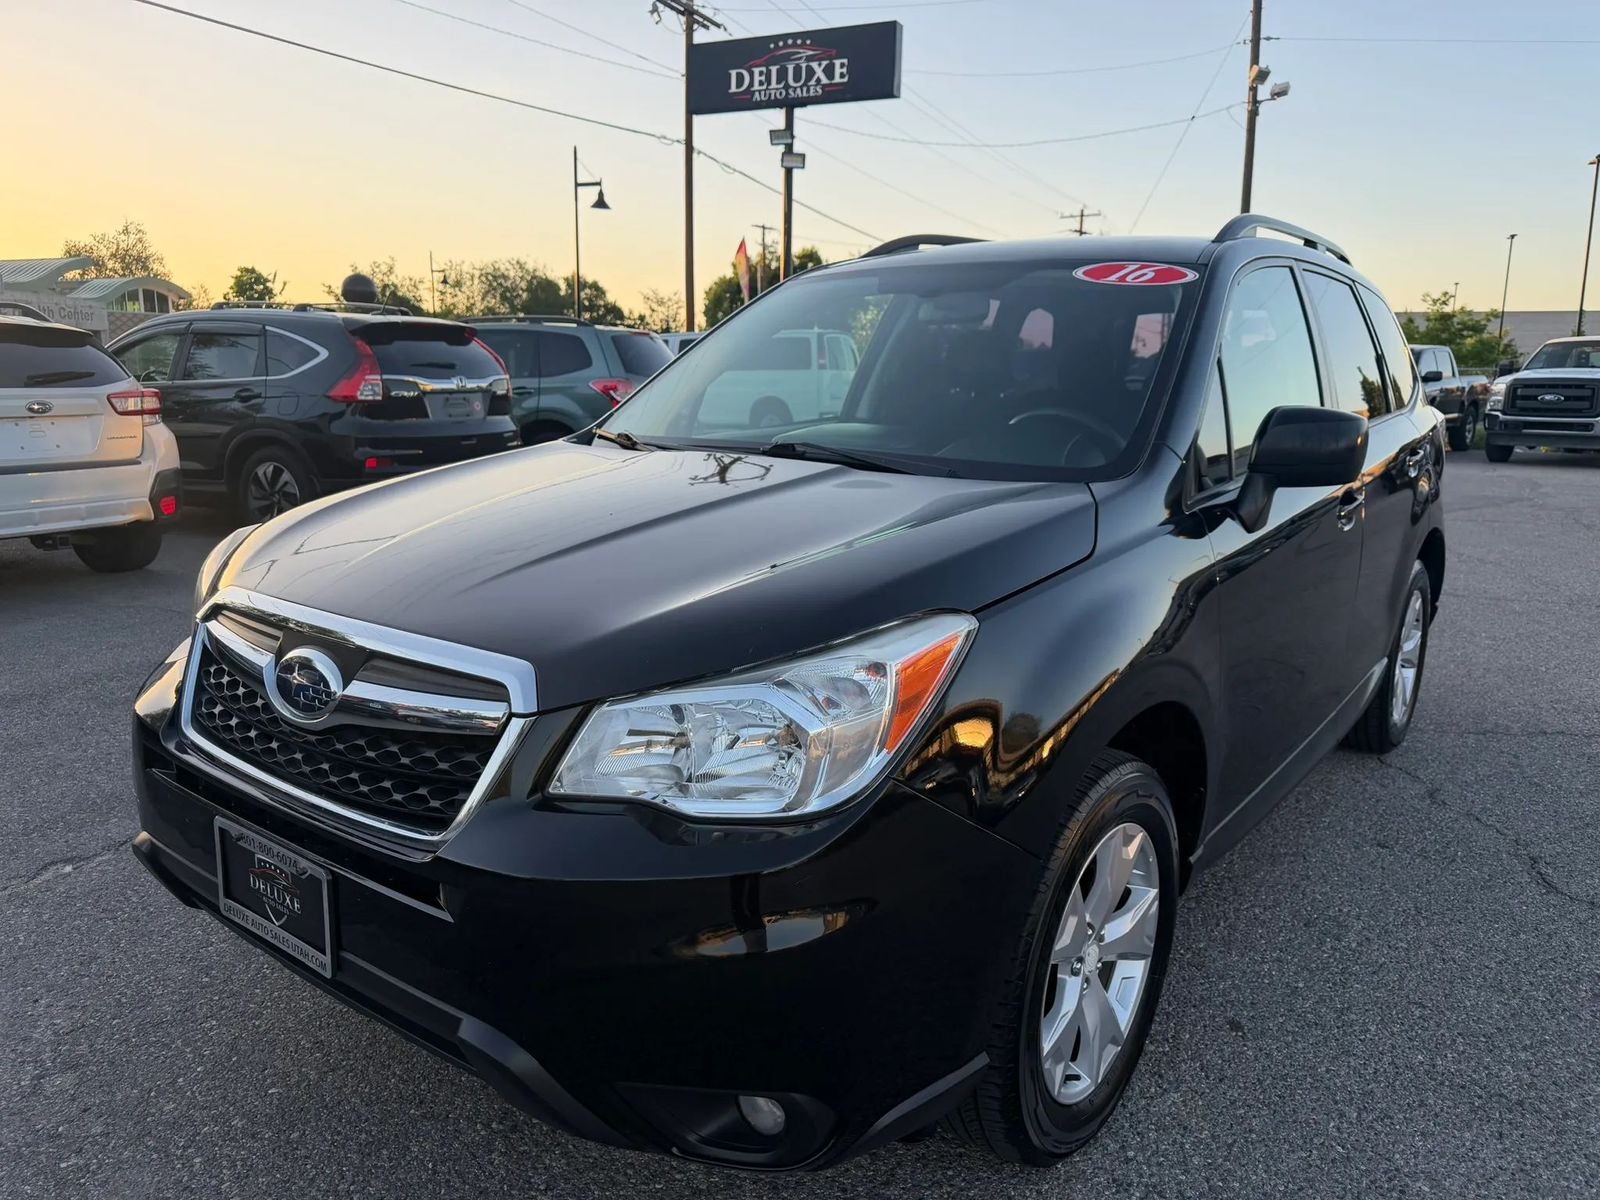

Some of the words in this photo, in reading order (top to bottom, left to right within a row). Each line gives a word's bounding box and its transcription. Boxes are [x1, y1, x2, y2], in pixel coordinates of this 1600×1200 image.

[728, 58, 849, 93] DELUXE
[752, 89, 786, 102] AUTO
[787, 85, 823, 98] SALES
[1101, 264, 1168, 283] 16
[58, 306, 94, 321] Center
[249, 873, 302, 915] DELUXE
[223, 902, 250, 923] DELUXE
[251, 919, 269, 936] AUTO
[269, 929, 291, 949] SALES
